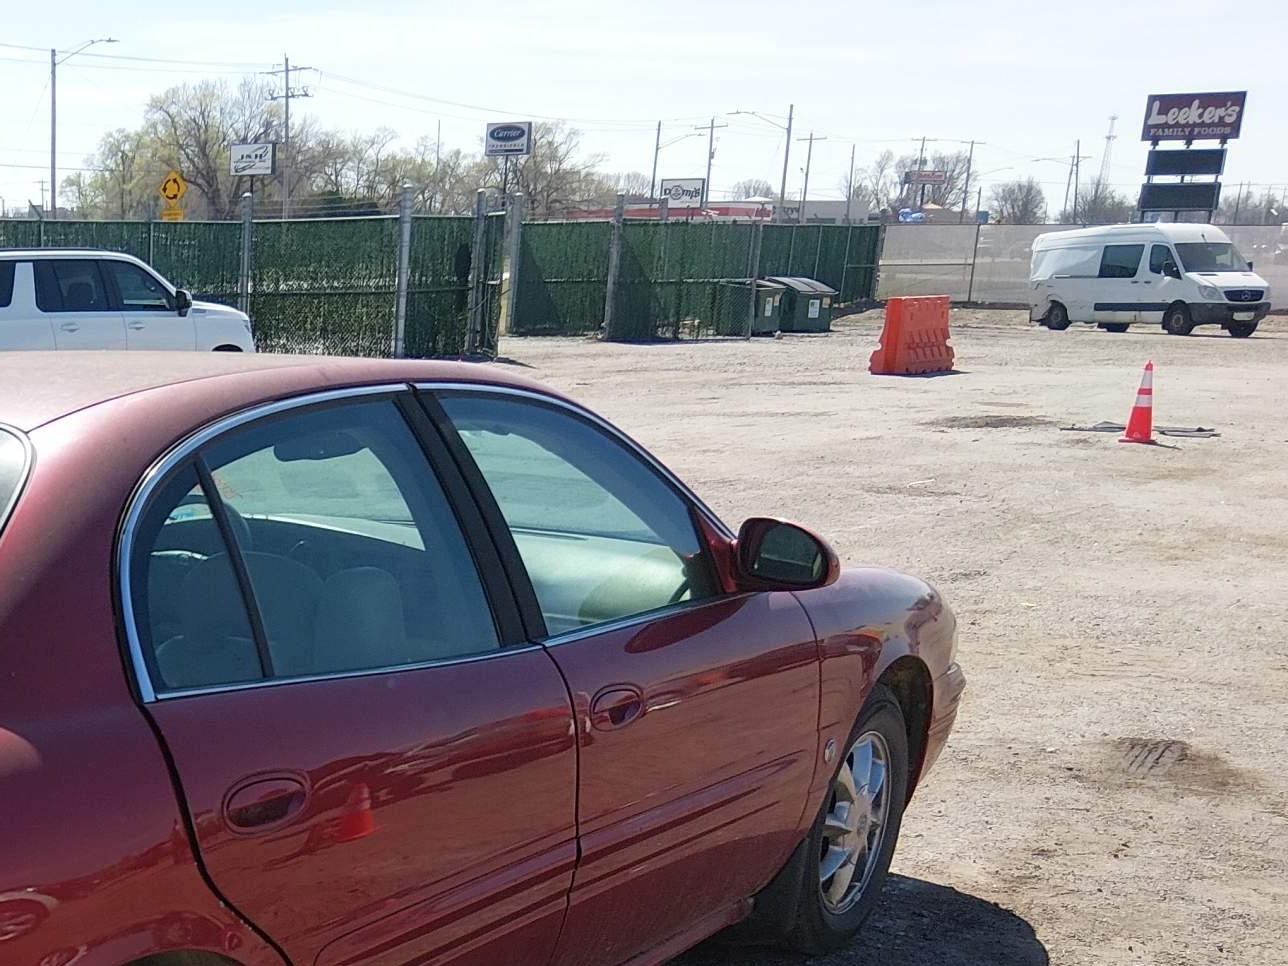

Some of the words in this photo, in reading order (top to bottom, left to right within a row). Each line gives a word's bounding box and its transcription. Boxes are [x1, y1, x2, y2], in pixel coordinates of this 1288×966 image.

[1147, 99, 1240, 125] Leeker's
[494, 129, 522, 138] Carrier
[1150, 127, 1191, 136] FAMILY
[1193, 126, 1232, 135] FOODS
